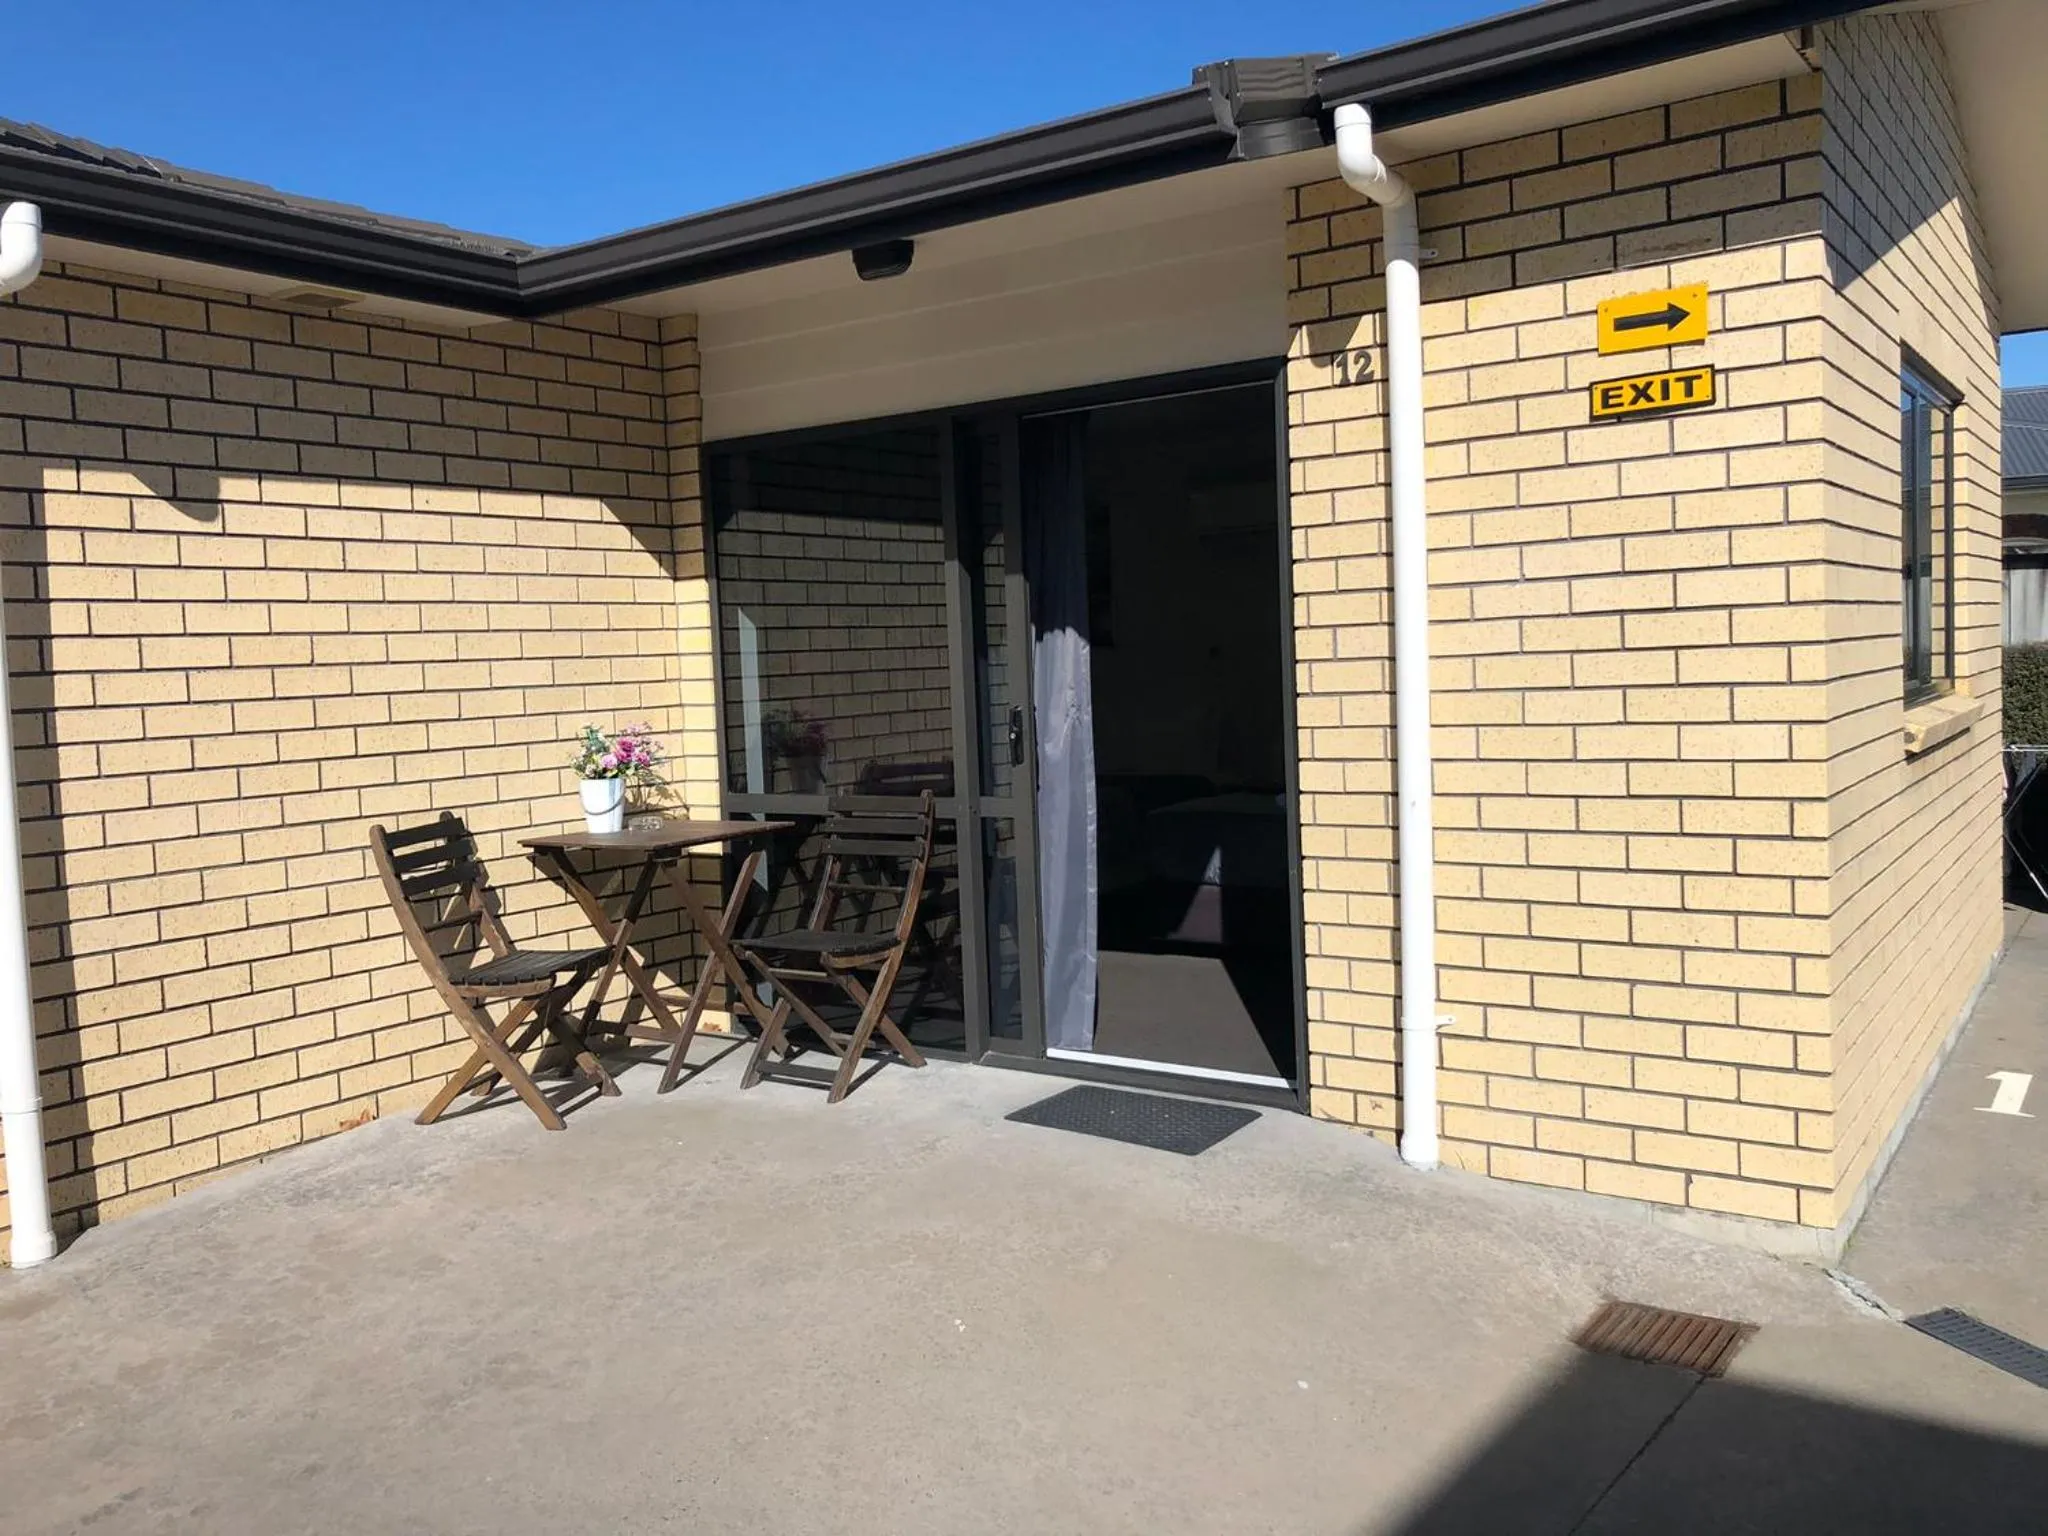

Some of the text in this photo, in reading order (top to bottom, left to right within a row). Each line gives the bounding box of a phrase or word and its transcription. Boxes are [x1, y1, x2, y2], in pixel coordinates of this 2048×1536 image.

[1336, 350, 1375, 385] 12
[1600, 374, 1703, 410] EXIT
[1972, 1071, 2036, 1118] 1
